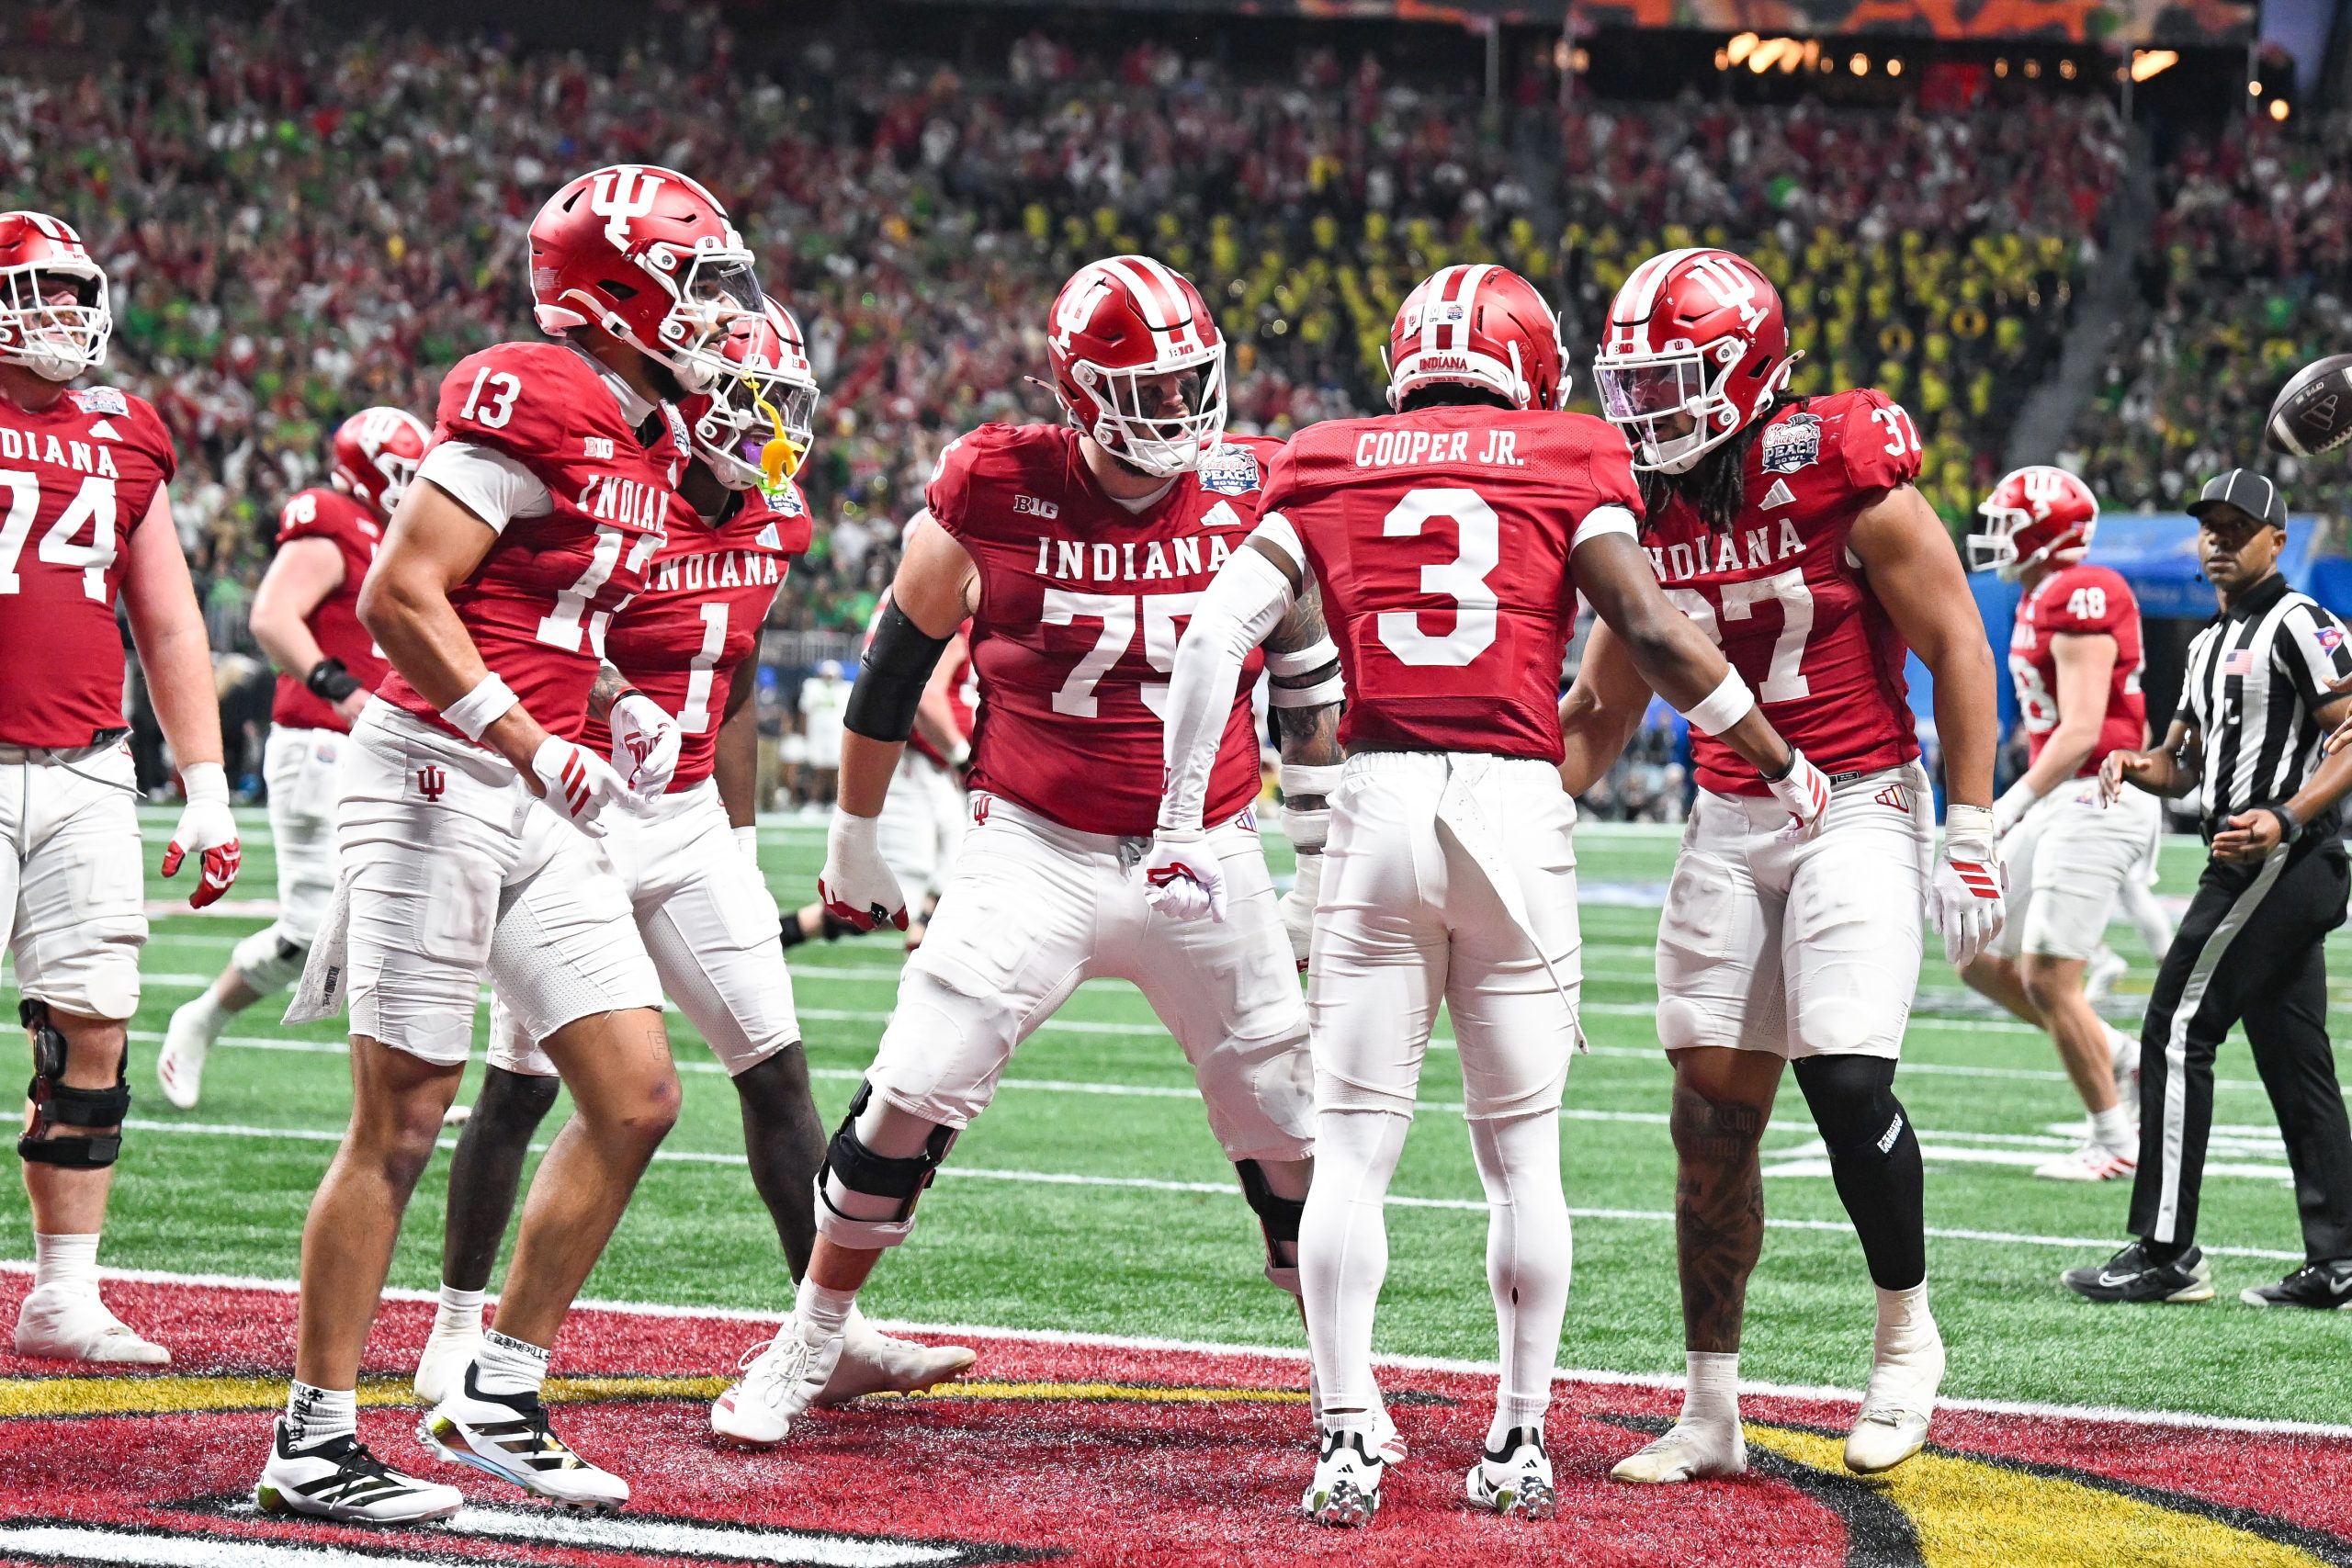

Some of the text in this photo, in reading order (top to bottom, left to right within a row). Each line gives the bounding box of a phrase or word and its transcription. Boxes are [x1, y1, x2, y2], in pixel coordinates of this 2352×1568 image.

[1419, 356, 1468, 370] INDIANA
[459, 366, 522, 429] 13
[0, 426, 119, 479] DIANA
[1355, 429, 1524, 468] COOPER JR.
[1764, 440, 1816, 465] PEACH
[1871, 403, 1922, 457] 37
[1200, 468, 1257, 483] PEACH
[1774, 455, 1805, 466] BOWL
[576, 474, 669, 533] INDIAN
[0, 469, 118, 604] 74
[1035, 535, 1232, 581] INDIANA
[1643, 517, 1807, 581] NDIANA
[1377, 488, 1499, 666] 3
[2067, 587, 2107, 620] 48
[677, 602, 730, 734] 1
